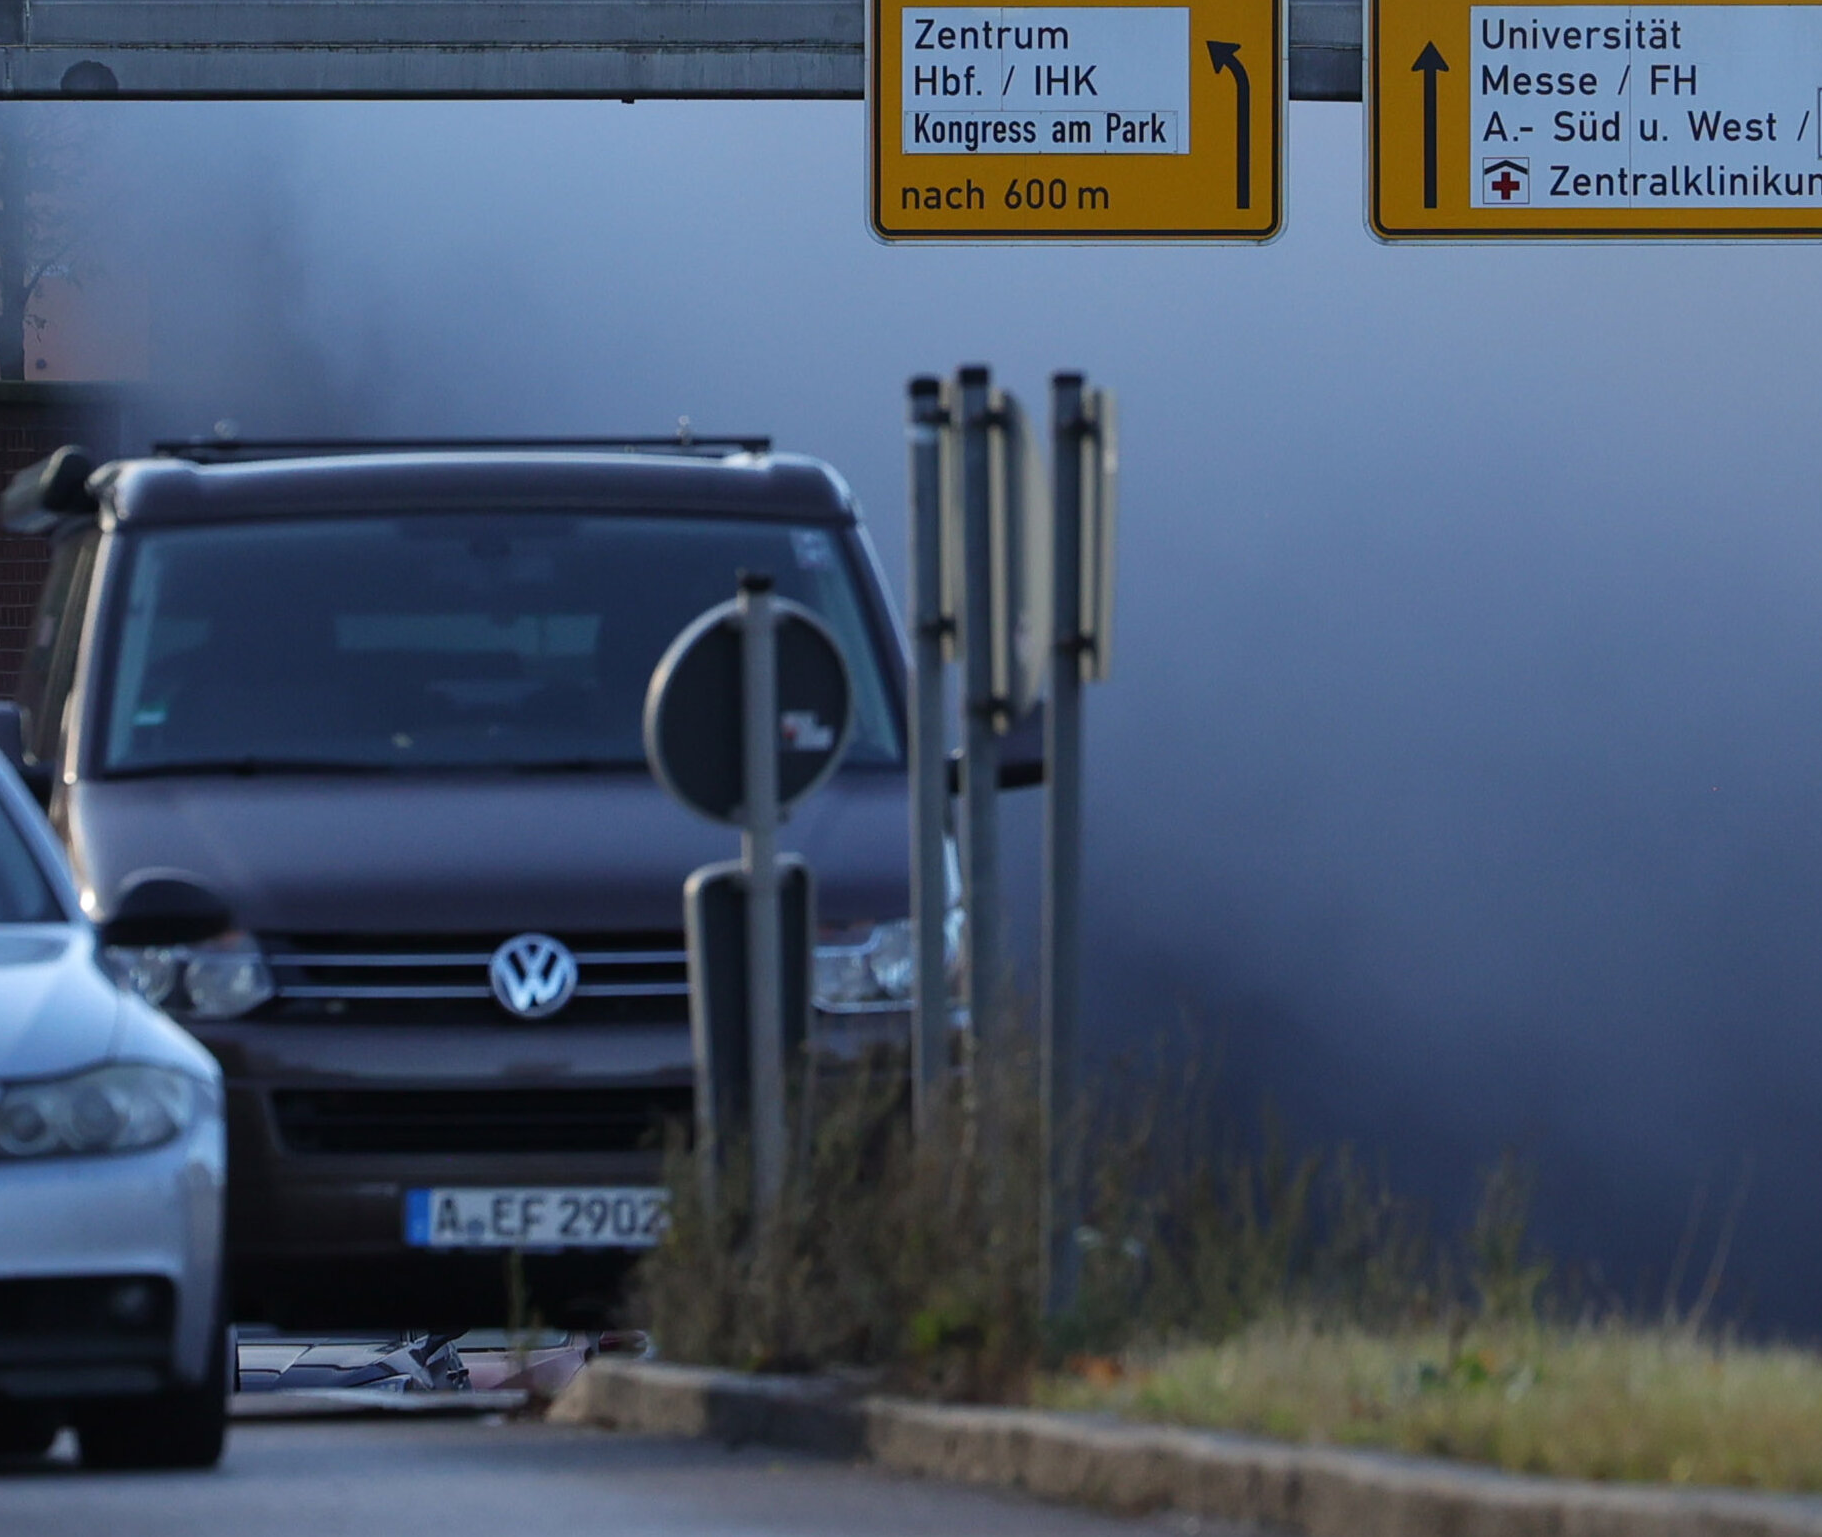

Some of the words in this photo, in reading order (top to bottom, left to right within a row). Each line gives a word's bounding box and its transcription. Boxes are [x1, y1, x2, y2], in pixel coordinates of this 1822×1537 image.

[915, 19, 1068, 49] Zentrum
[1483, 19, 1681, 49] Universität
[915, 66, 981, 96] Hbf.
[1002, 65, 1015, 96] /
[1036, 65, 1097, 95] IHK
[1483, 65, 1597, 95] Messe
[1618, 65, 1630, 95] /
[1651, 65, 1696, 95] FH
[914, 113, 1036, 151] Kongress
[1052, 121, 1090, 143] am
[1107, 113, 1166, 143] Park
[1554, 111, 1619, 141] Süd
[1640, 119, 1667, 141] u.
[1688, 111, 1776, 141] West
[1797, 111, 1809, 141] /
[902, 179, 984, 209] nach
[1005, 179, 1066, 209] 600
[1078, 187, 1108, 209] m
[436, 1198, 459, 1234] A
[491, 1197, 545, 1235] EF
[559, 1196, 667, 1236] 2902
